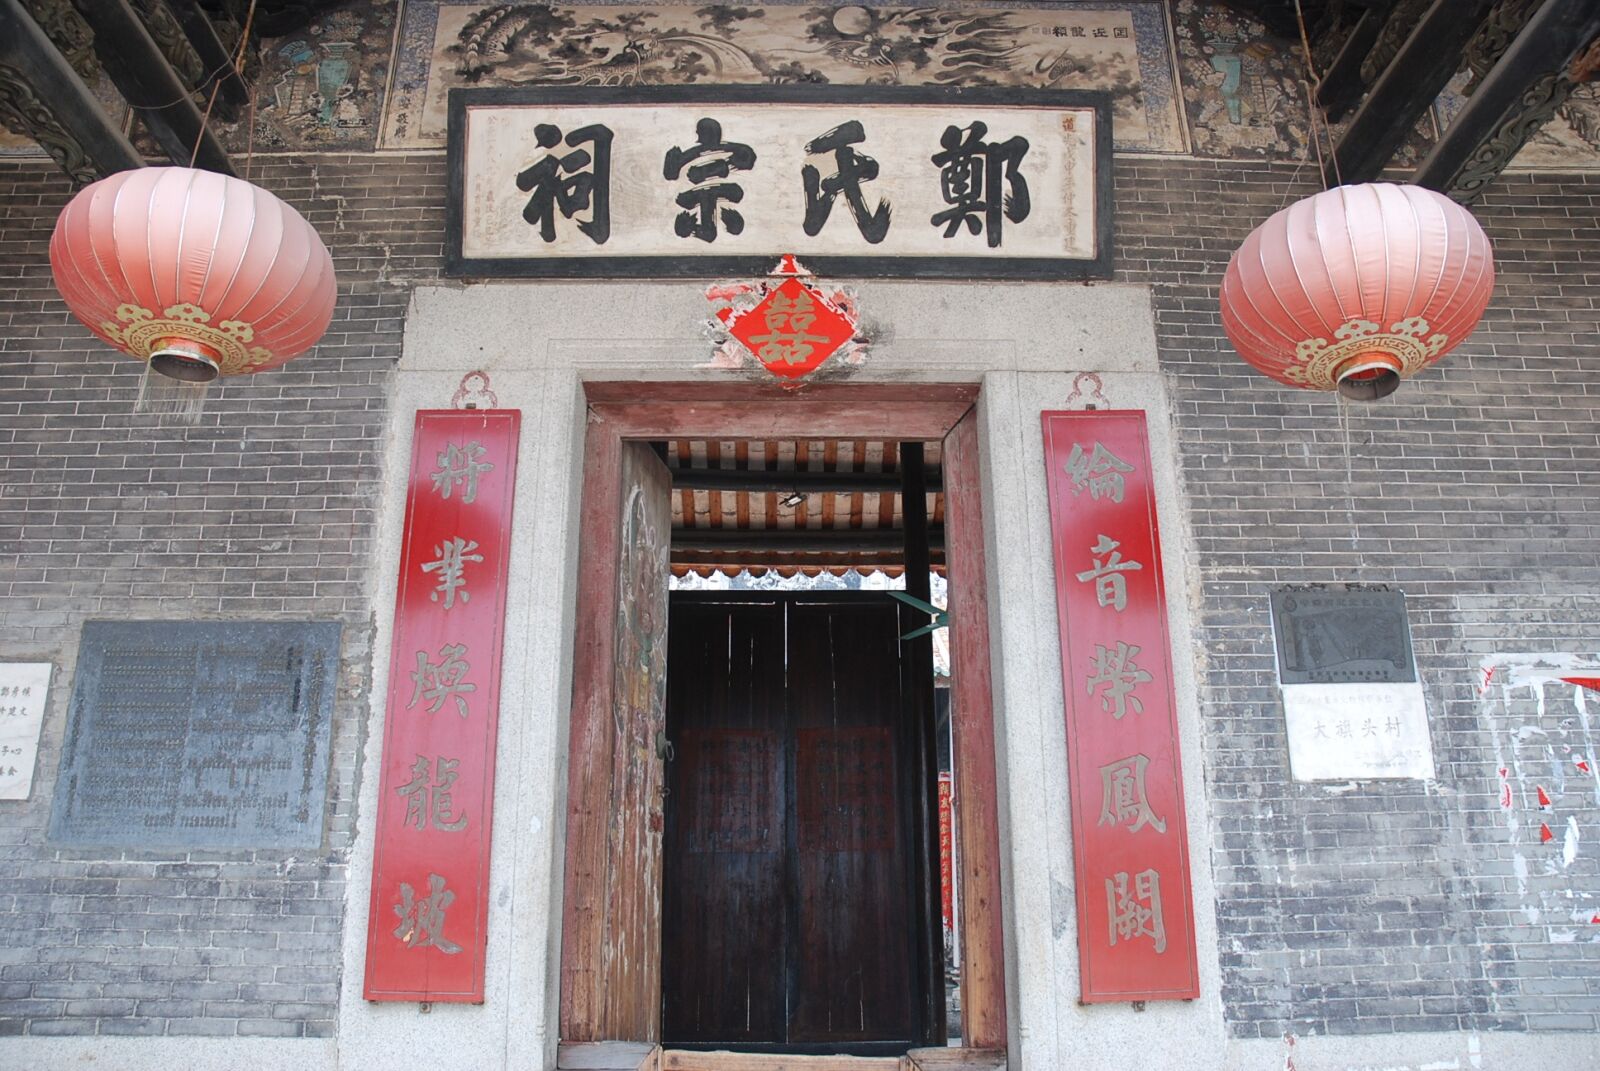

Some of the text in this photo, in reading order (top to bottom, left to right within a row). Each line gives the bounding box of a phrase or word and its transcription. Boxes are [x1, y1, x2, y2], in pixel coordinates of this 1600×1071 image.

[516, 117, 1031, 248] 鄭氏宗祠
[1313, 716, 1403, 739] 大旗头村
